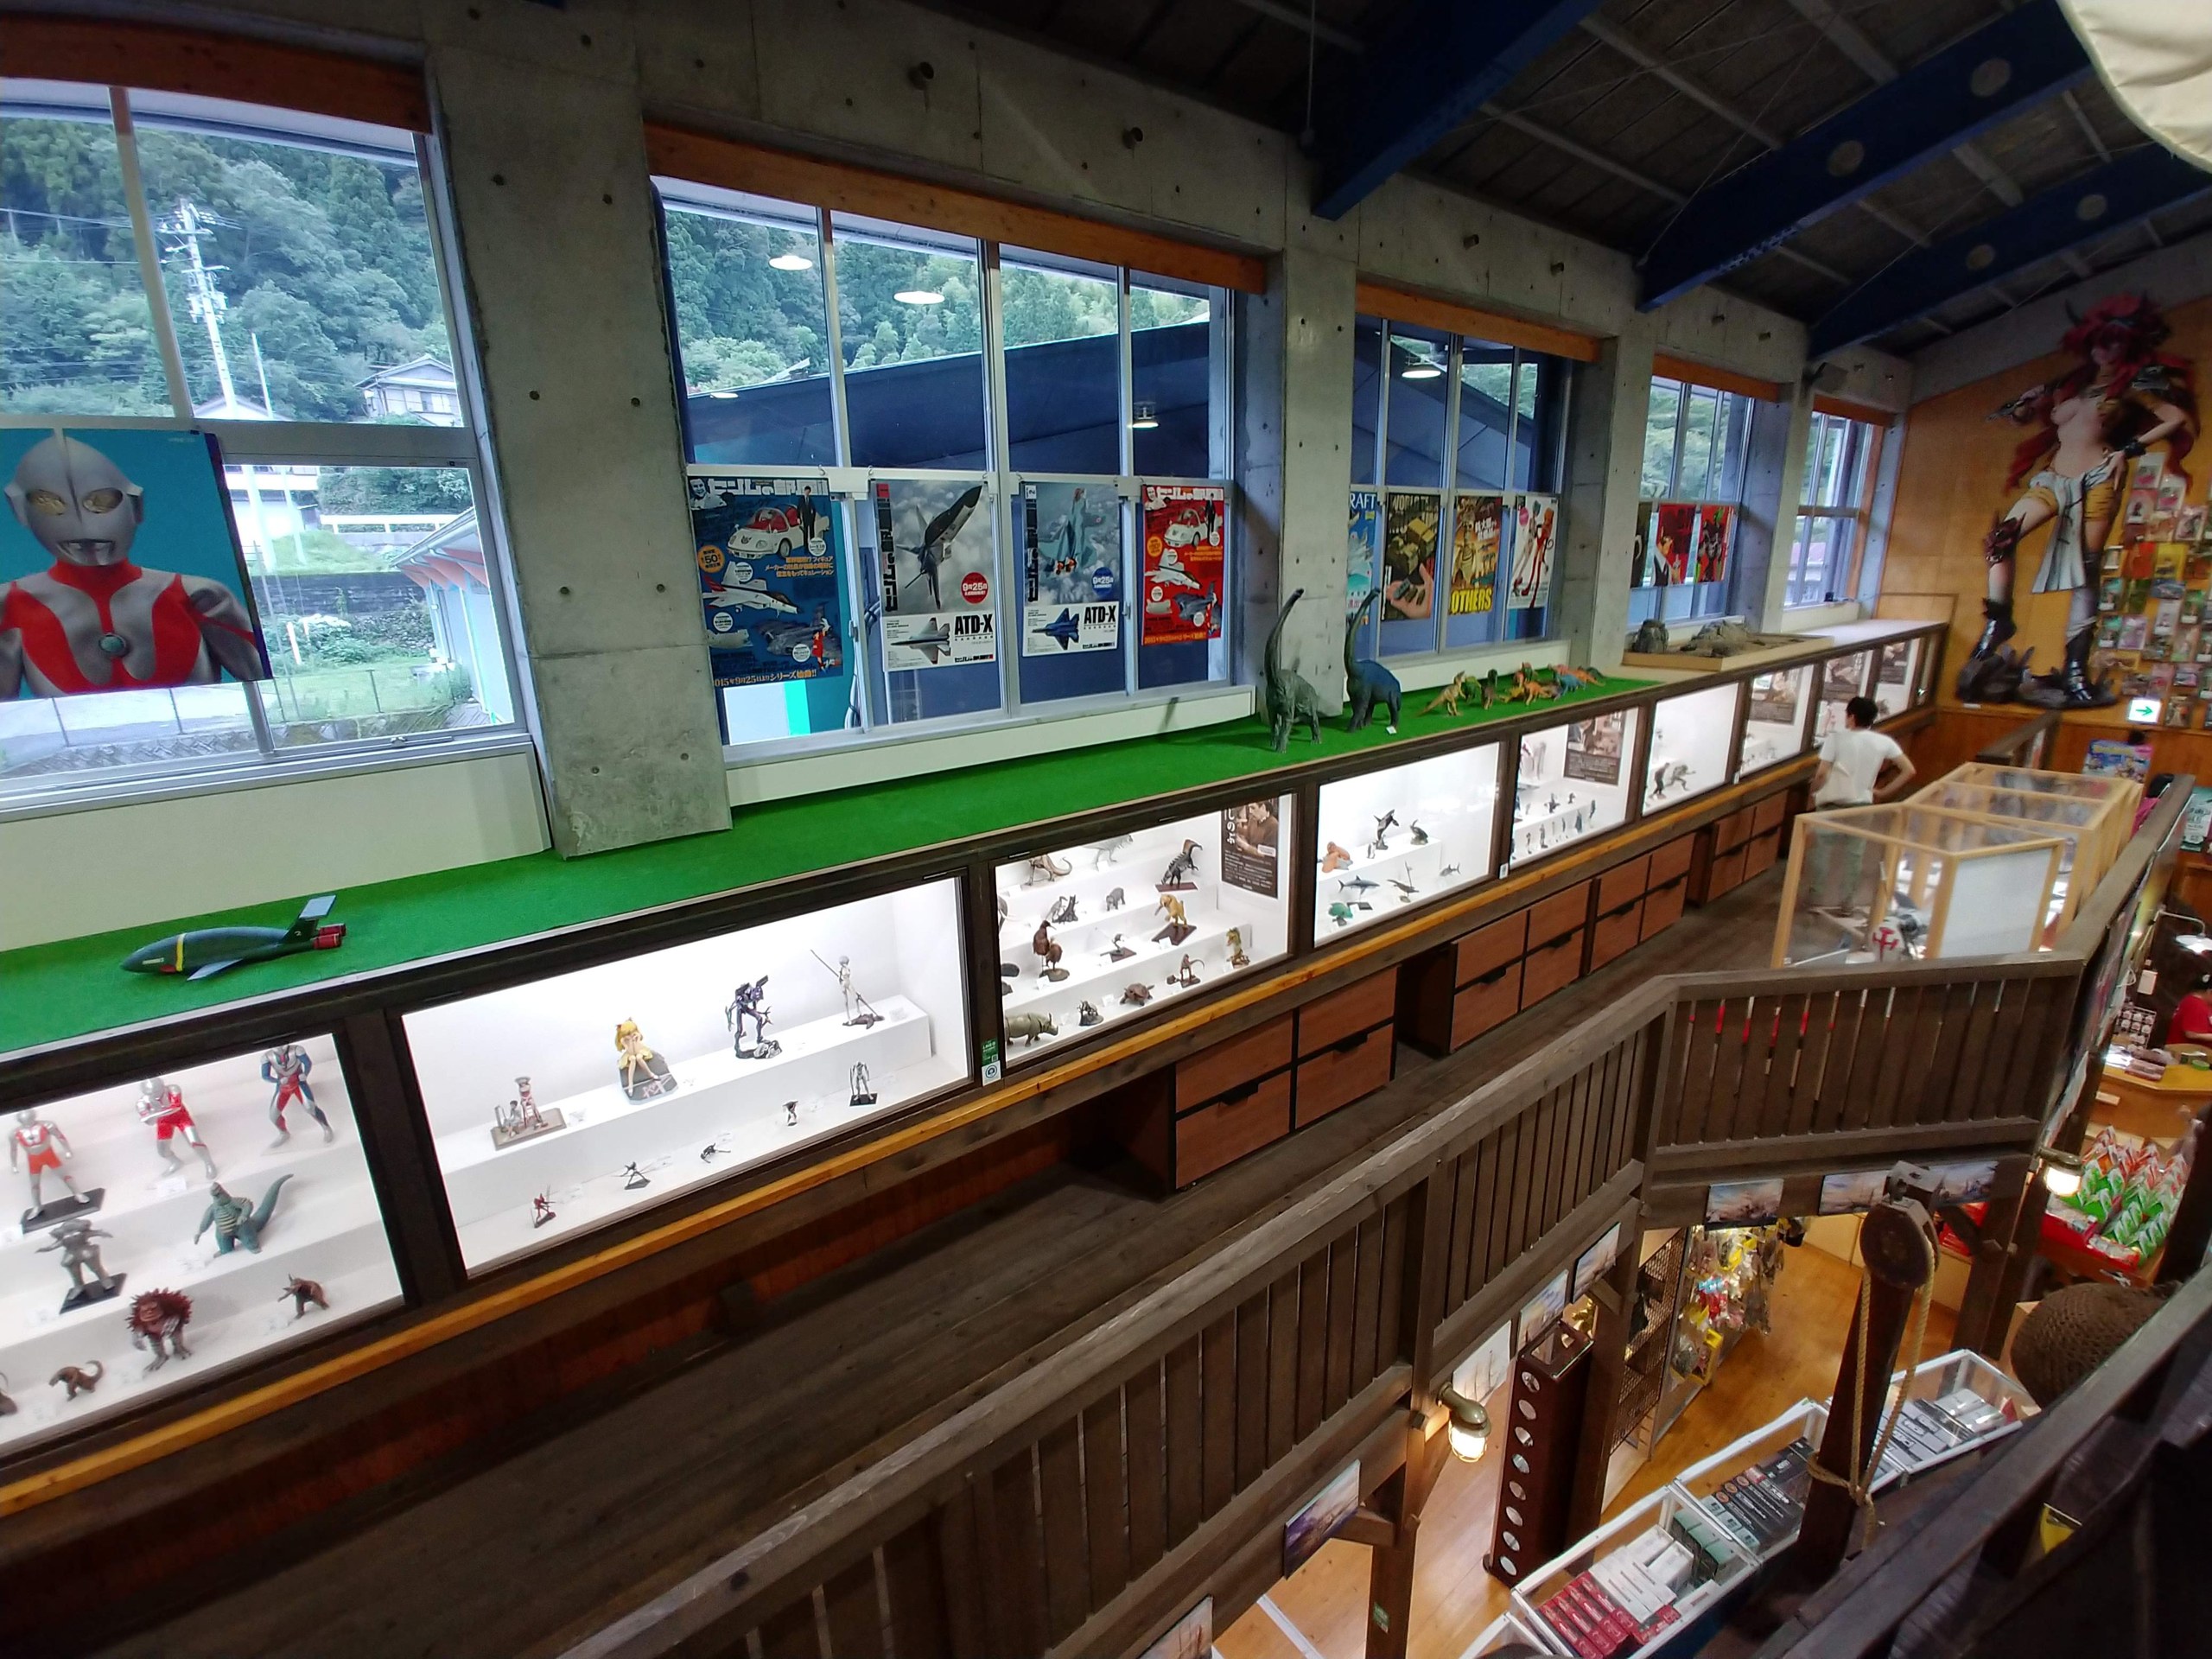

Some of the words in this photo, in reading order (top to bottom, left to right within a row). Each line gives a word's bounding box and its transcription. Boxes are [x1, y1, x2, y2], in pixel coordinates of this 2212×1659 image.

[1450, 588, 1492, 614] OTHERS
[954, 614, 994, 635] ATD-X
[1084, 605, 1116, 624] ATD-X
